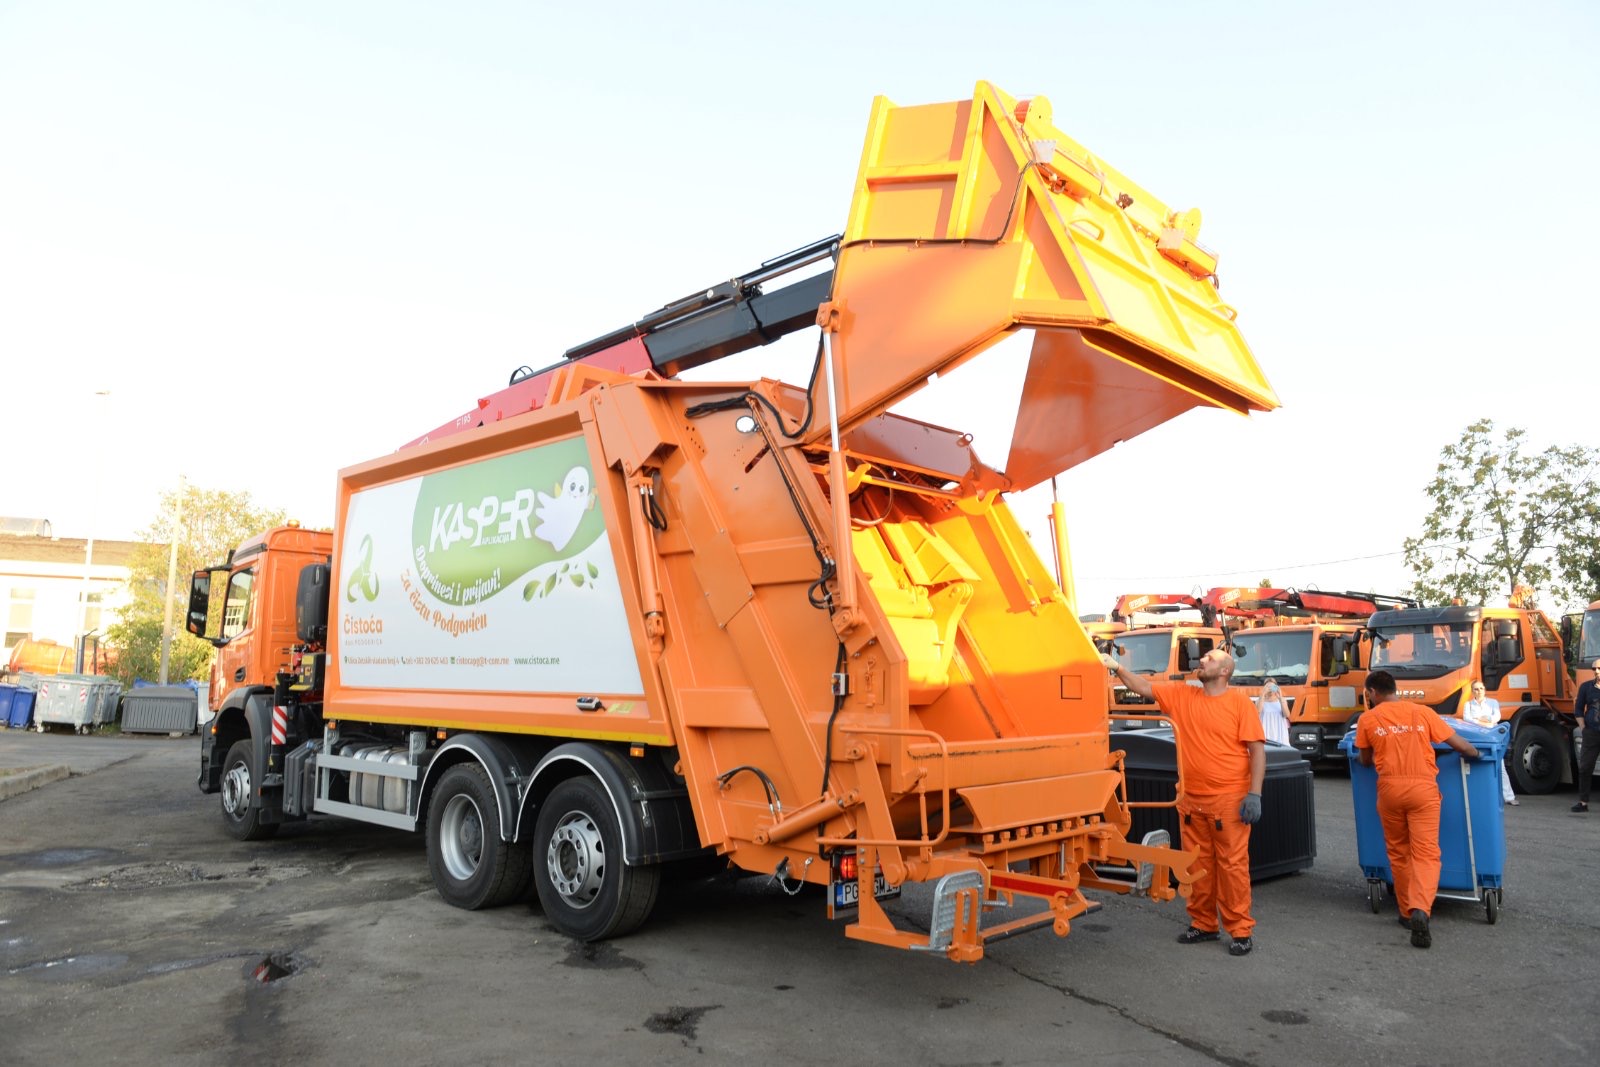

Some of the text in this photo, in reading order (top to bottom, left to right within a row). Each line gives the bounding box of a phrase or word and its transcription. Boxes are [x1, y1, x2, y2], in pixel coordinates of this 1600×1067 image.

[428, 488, 535, 553] KASPER
[416, 545, 501, 606] Doprinesi i prijavi!
[400, 568, 488, 638] Za čistu Podgoricu
[344, 614, 383, 634] Čistoća
[514, 655, 560, 665] www.cistoca.me
[1395, 690, 1425, 698] VECO
[844, 883, 859, 902] PG
